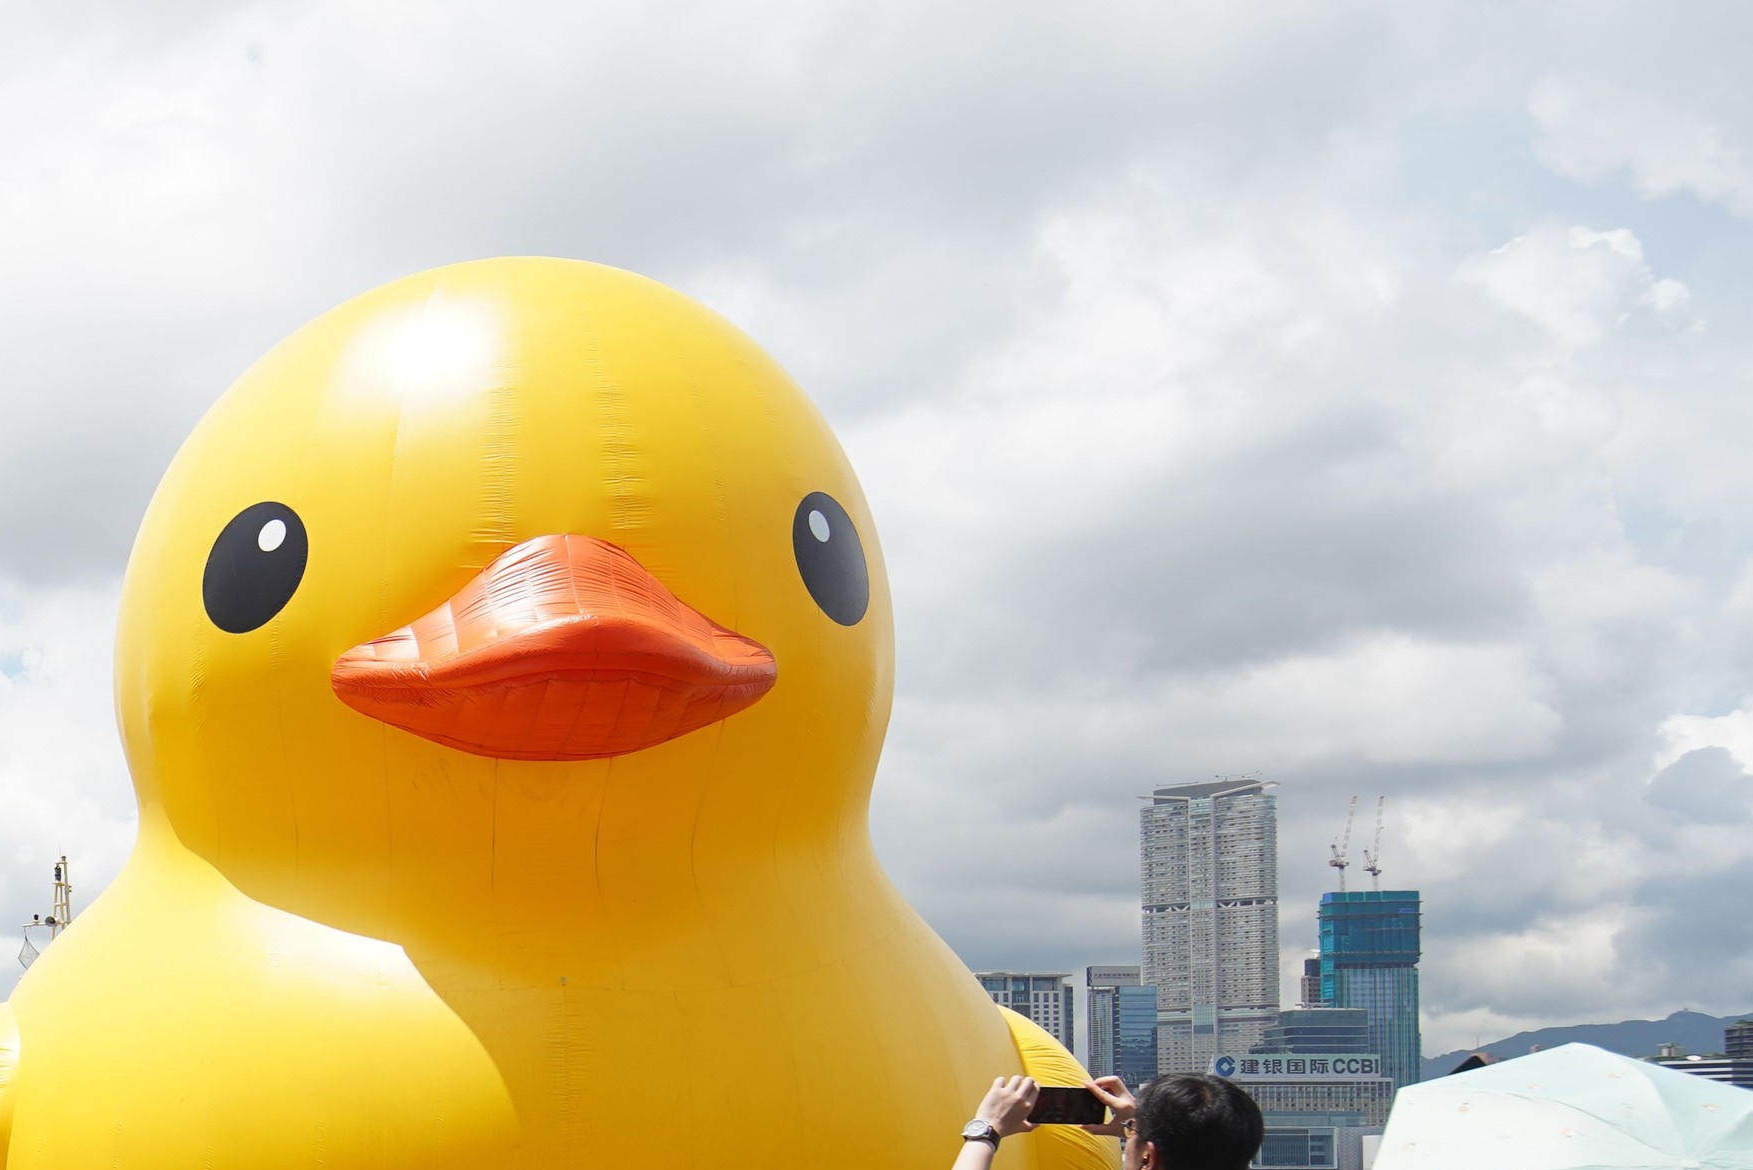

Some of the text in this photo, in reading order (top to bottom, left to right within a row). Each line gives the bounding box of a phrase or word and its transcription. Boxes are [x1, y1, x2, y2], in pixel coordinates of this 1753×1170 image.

[1240, 1058, 1379, 1075] 建银国际 CCBI
